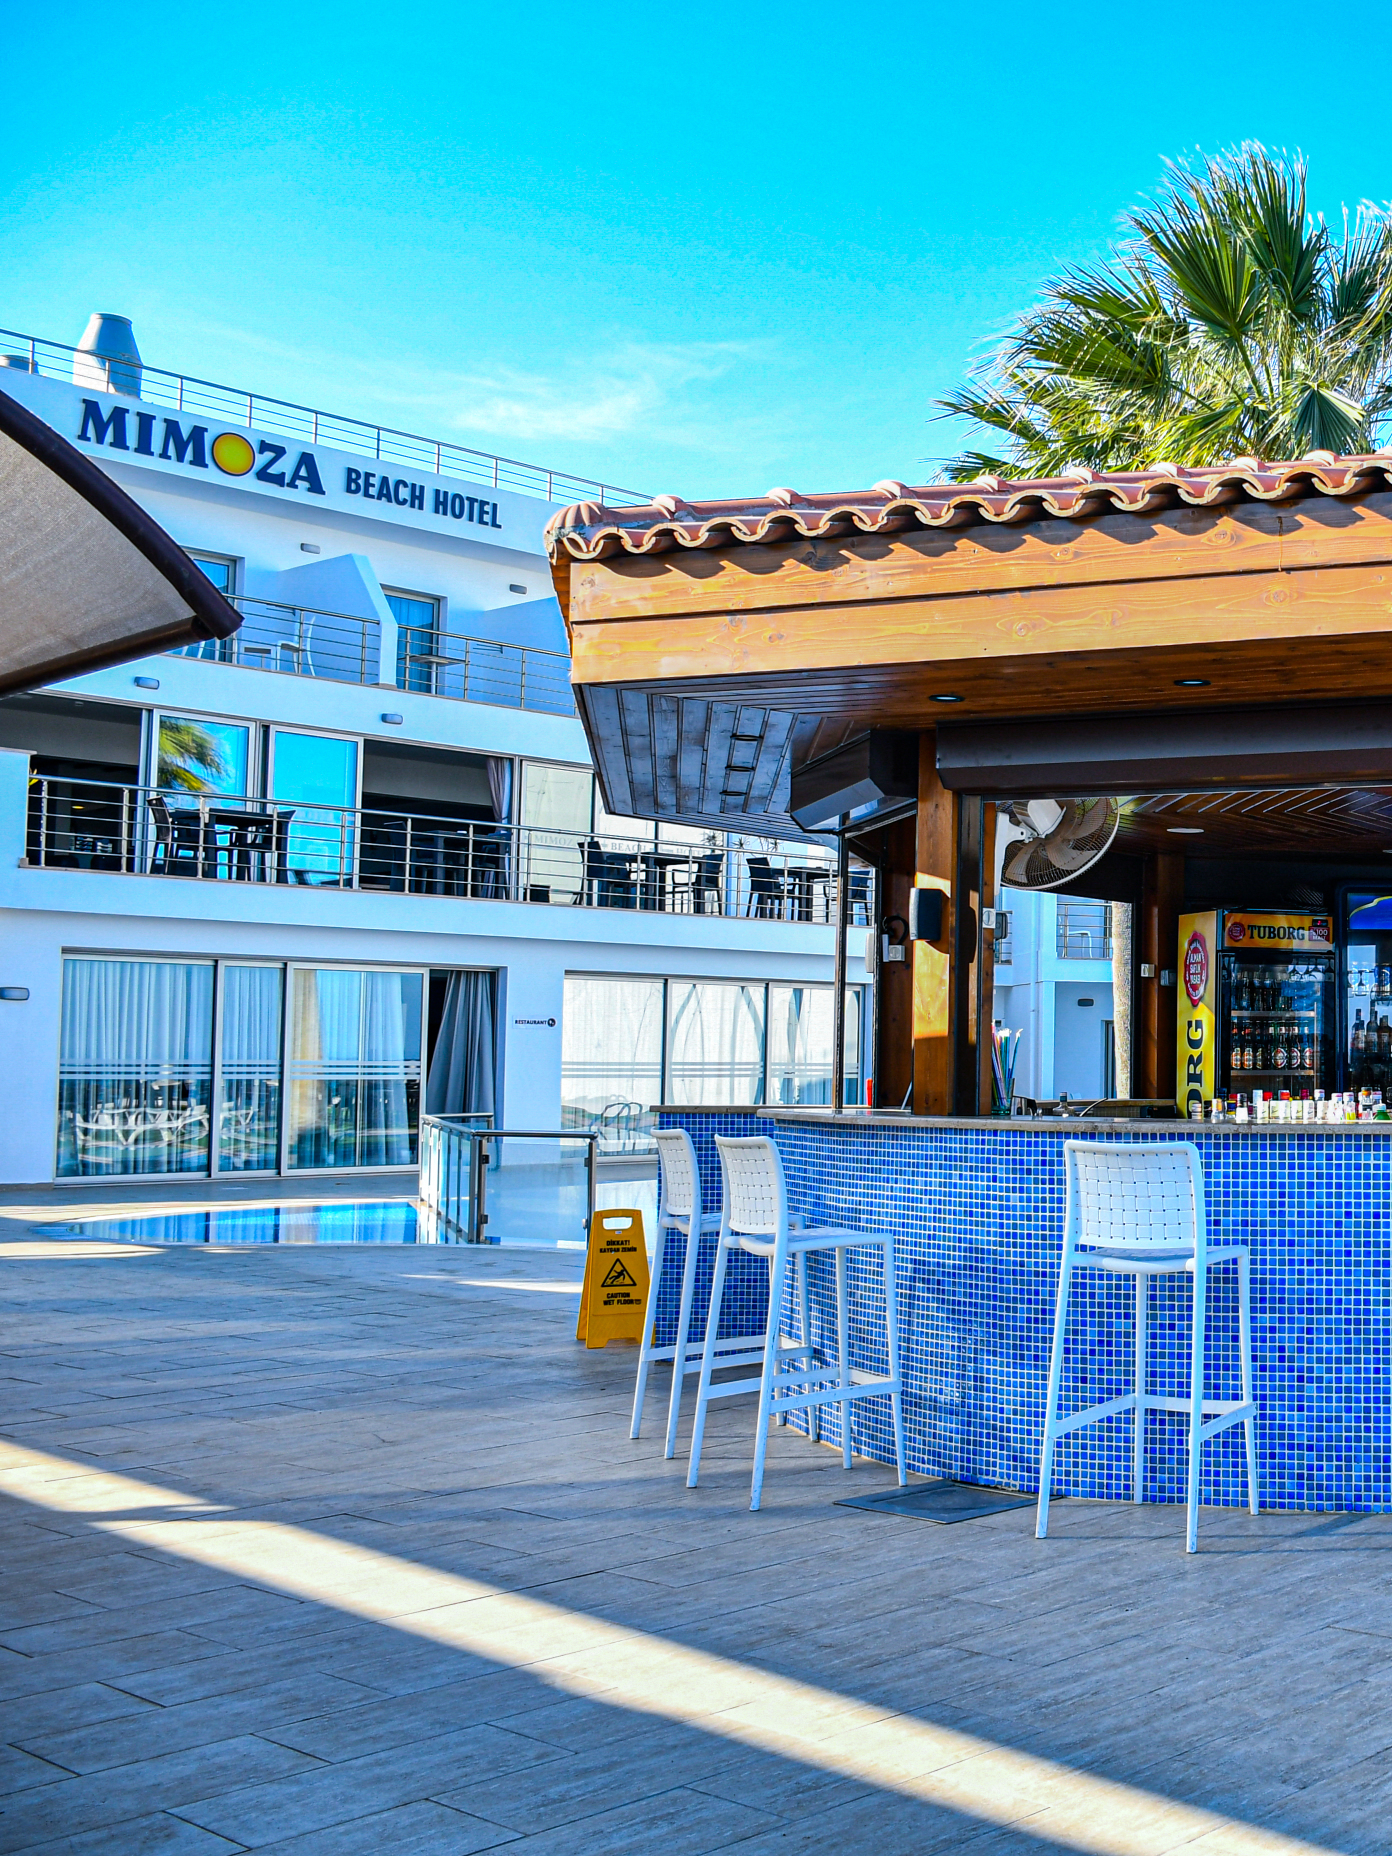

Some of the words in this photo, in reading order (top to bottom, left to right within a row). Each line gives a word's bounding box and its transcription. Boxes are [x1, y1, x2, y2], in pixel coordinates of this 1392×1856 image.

[78, 398, 326, 495] MIMOZA
[345, 466, 425, 512] BEACH
[433, 488, 502, 529] HOTEL
[1247, 924, 1306, 941] TUBORG
